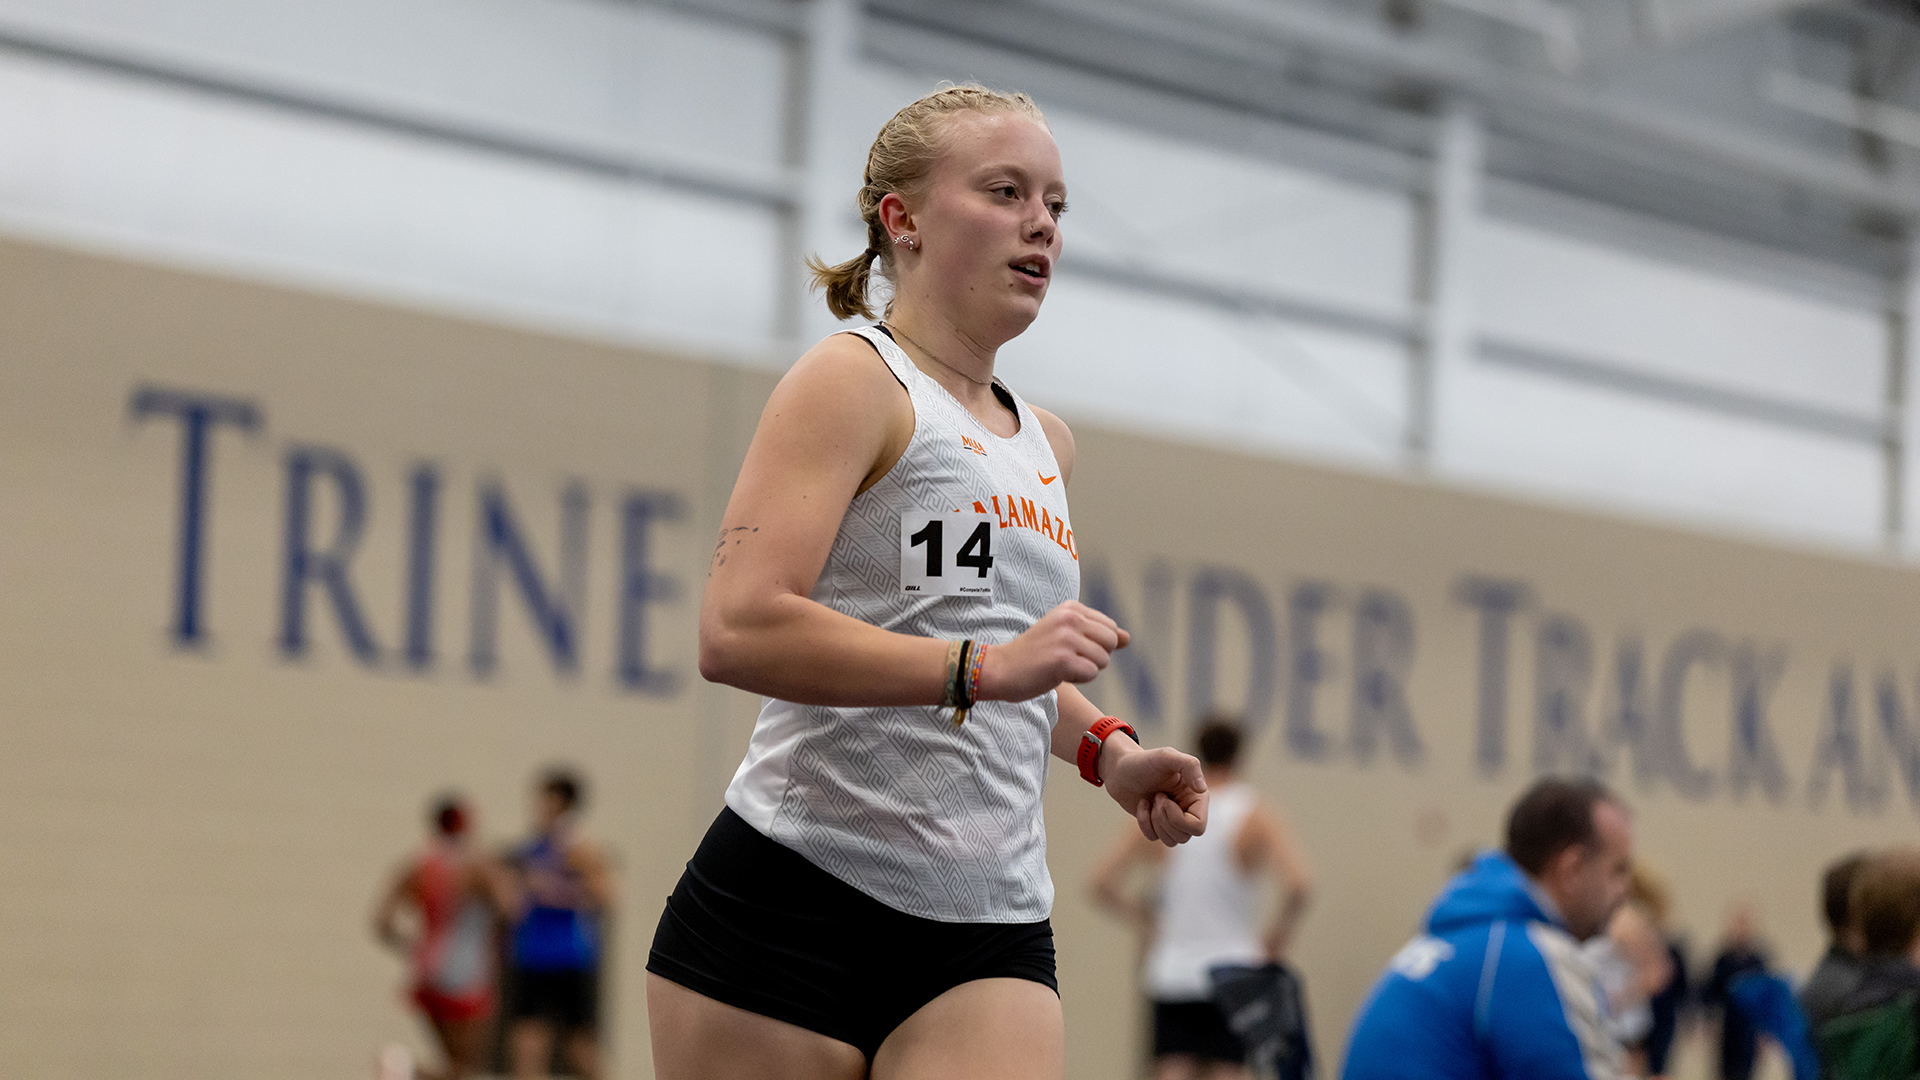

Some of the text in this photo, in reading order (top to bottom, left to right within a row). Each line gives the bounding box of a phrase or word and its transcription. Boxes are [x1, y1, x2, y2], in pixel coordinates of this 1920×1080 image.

[910, 520, 994, 578] 14
[953, 494, 1079, 562] LAMAZO
[131, 385, 690, 693] TRINE
[1081, 562, 1424, 765] NDER
[1450, 574, 1790, 802] TRACK
